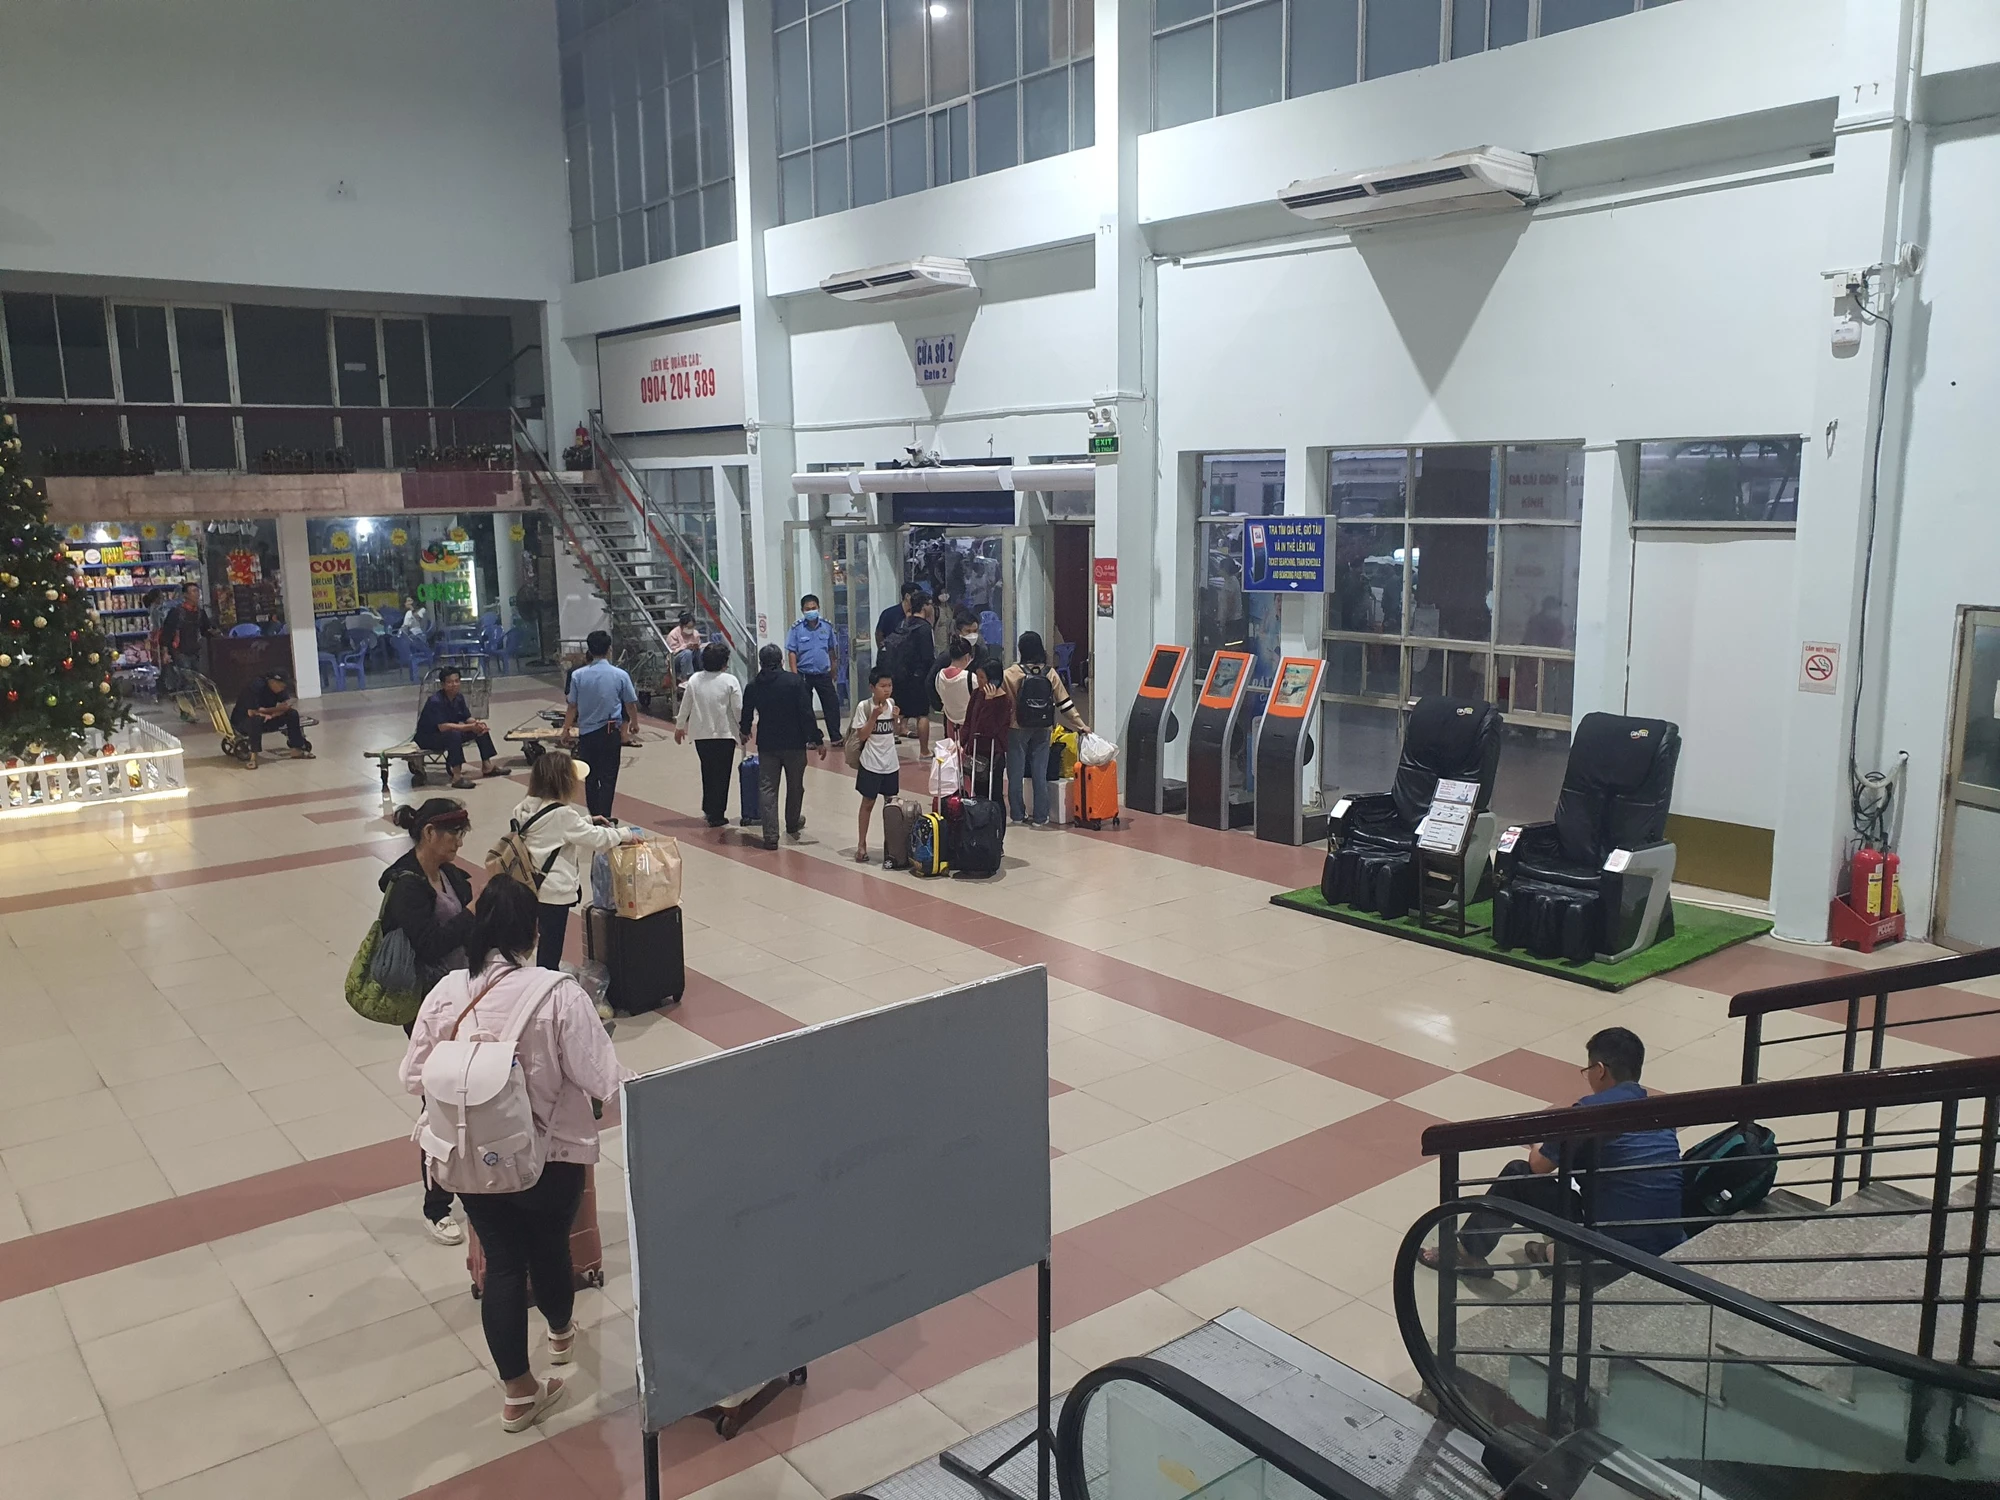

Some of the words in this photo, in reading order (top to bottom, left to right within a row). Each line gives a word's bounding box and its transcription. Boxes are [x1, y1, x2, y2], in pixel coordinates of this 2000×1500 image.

[917, 339, 933, 366] CỬA
[935, 336, 945, 364] SỐ
[948, 341, 954, 363] 2
[942, 367, 947, 379] 2
[640, 375, 667, 403] 0904
[669, 371, 691, 400] 204
[694, 367, 716, 398] 389
[1095, 438, 1113, 446] EXIT
[1268, 525, 1278, 535] TRA
[309, 558, 352, 573] CƠM
[873, 721, 894, 733] BRON
